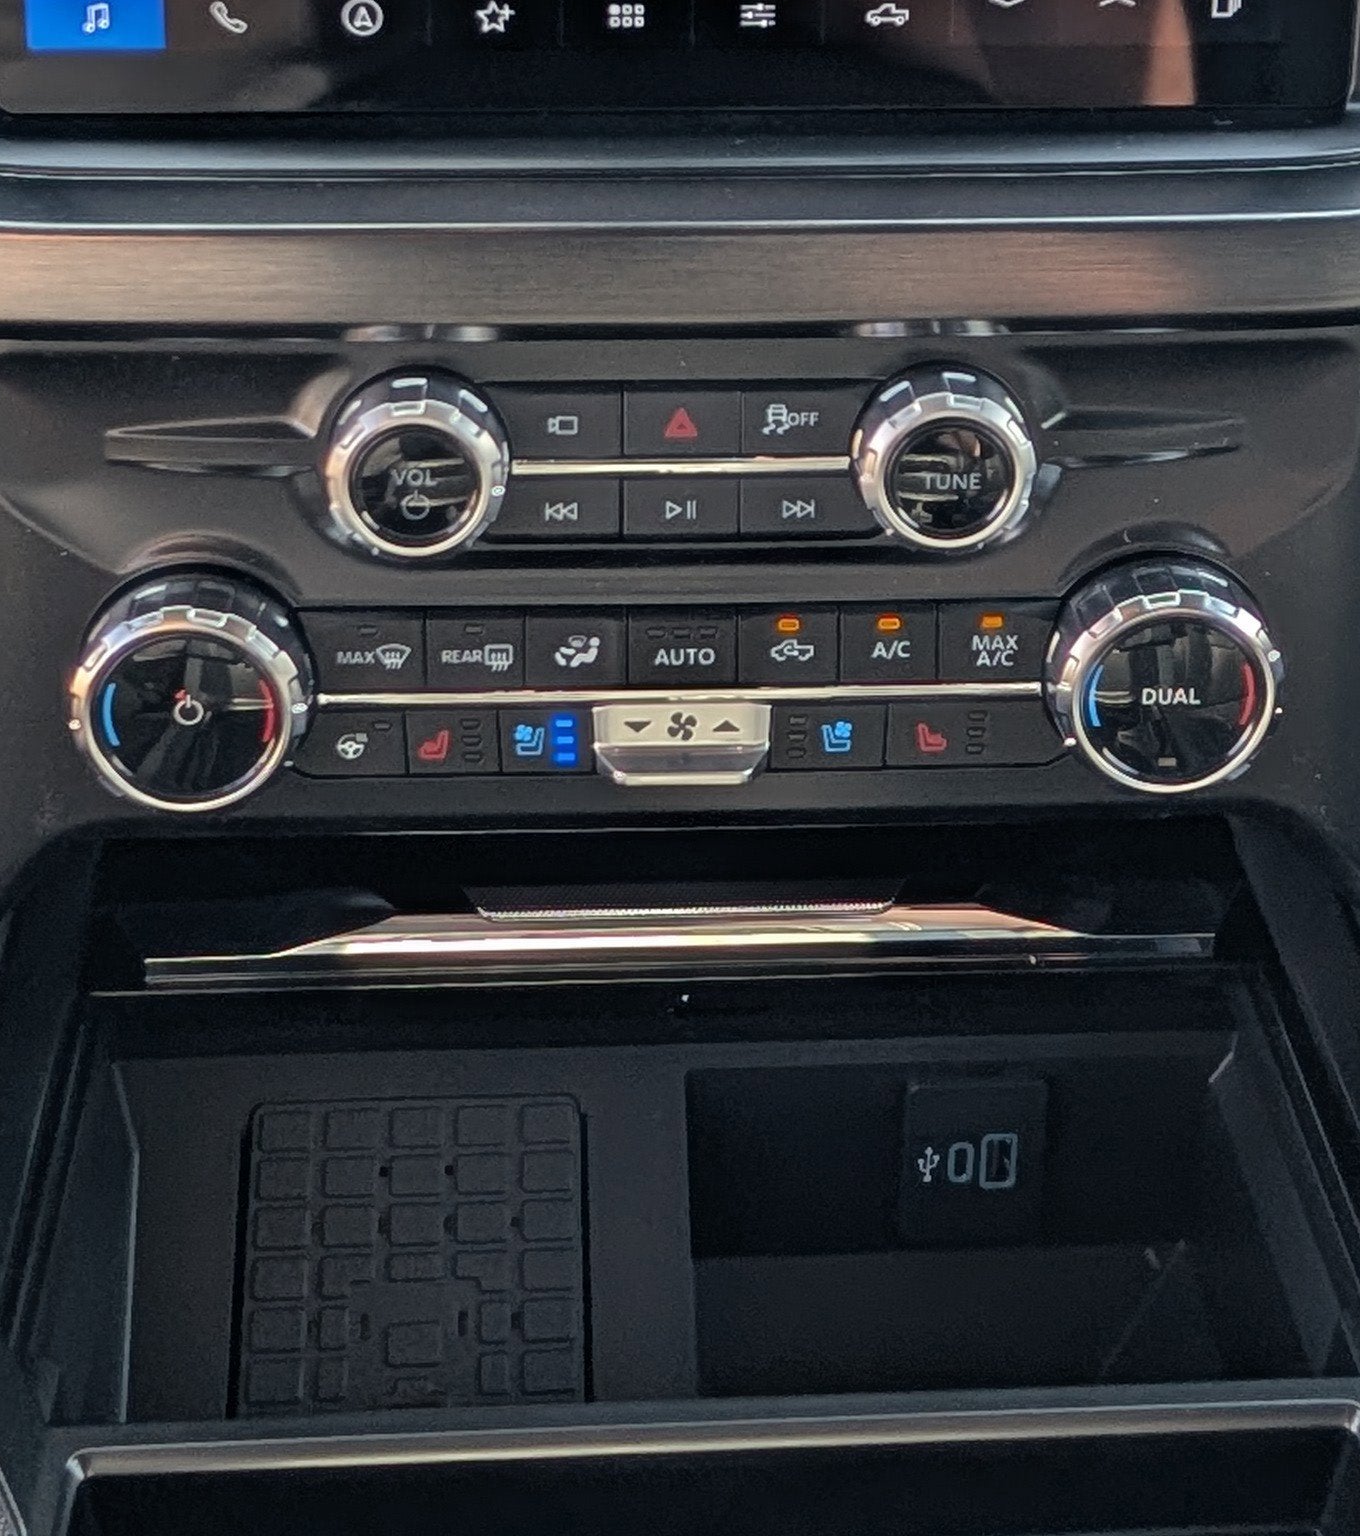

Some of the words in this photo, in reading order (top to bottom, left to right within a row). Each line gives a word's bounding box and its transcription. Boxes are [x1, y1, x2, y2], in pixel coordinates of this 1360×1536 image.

[787, 409, 820, 428] OFF
[391, 467, 437, 487] VOL
[922, 472, 983, 491] TUNE
[871, 641, 911, 661] A/C
[971, 636, 1019, 652] MAX
[337, 651, 375, 665] MAX
[441, 649, 483, 664] REAR
[654, 648, 716, 667] AUTO
[975, 650, 1015, 668] A/C
[1141, 687, 1201, 707] DUAL
